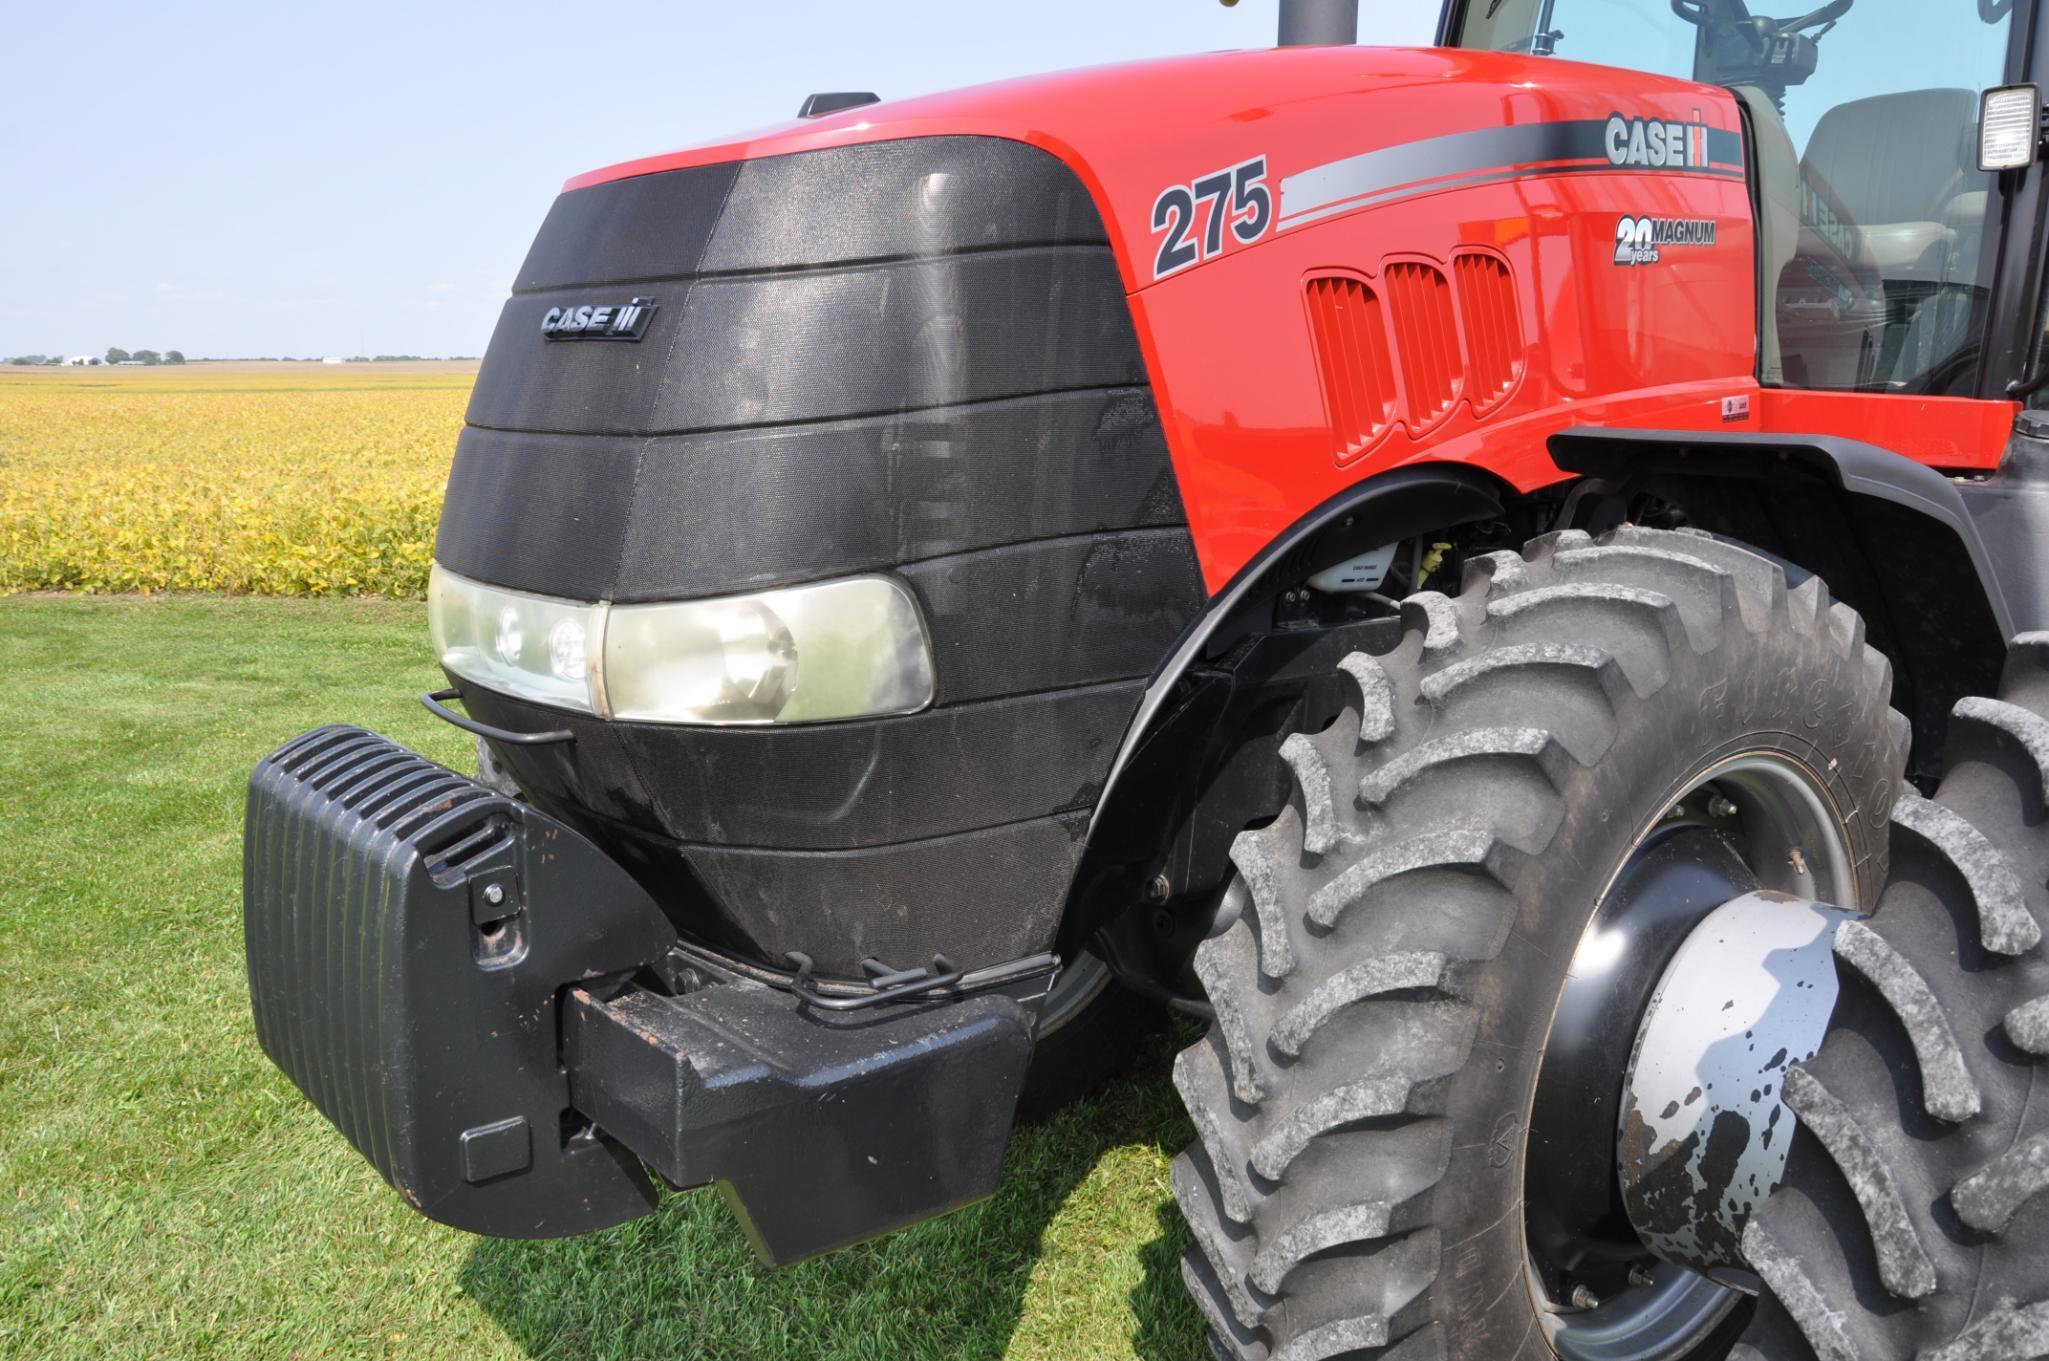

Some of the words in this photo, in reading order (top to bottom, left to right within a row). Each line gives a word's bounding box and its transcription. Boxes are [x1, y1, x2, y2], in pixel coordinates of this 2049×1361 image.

[1604, 114, 1685, 168] CASE
[1151, 153, 1273, 281] 275
[1614, 216, 1653, 263] 20
[1652, 218, 1716, 244] MAGNUM
[1630, 248, 1660, 265] years
[541, 306, 613, 333] CASE
